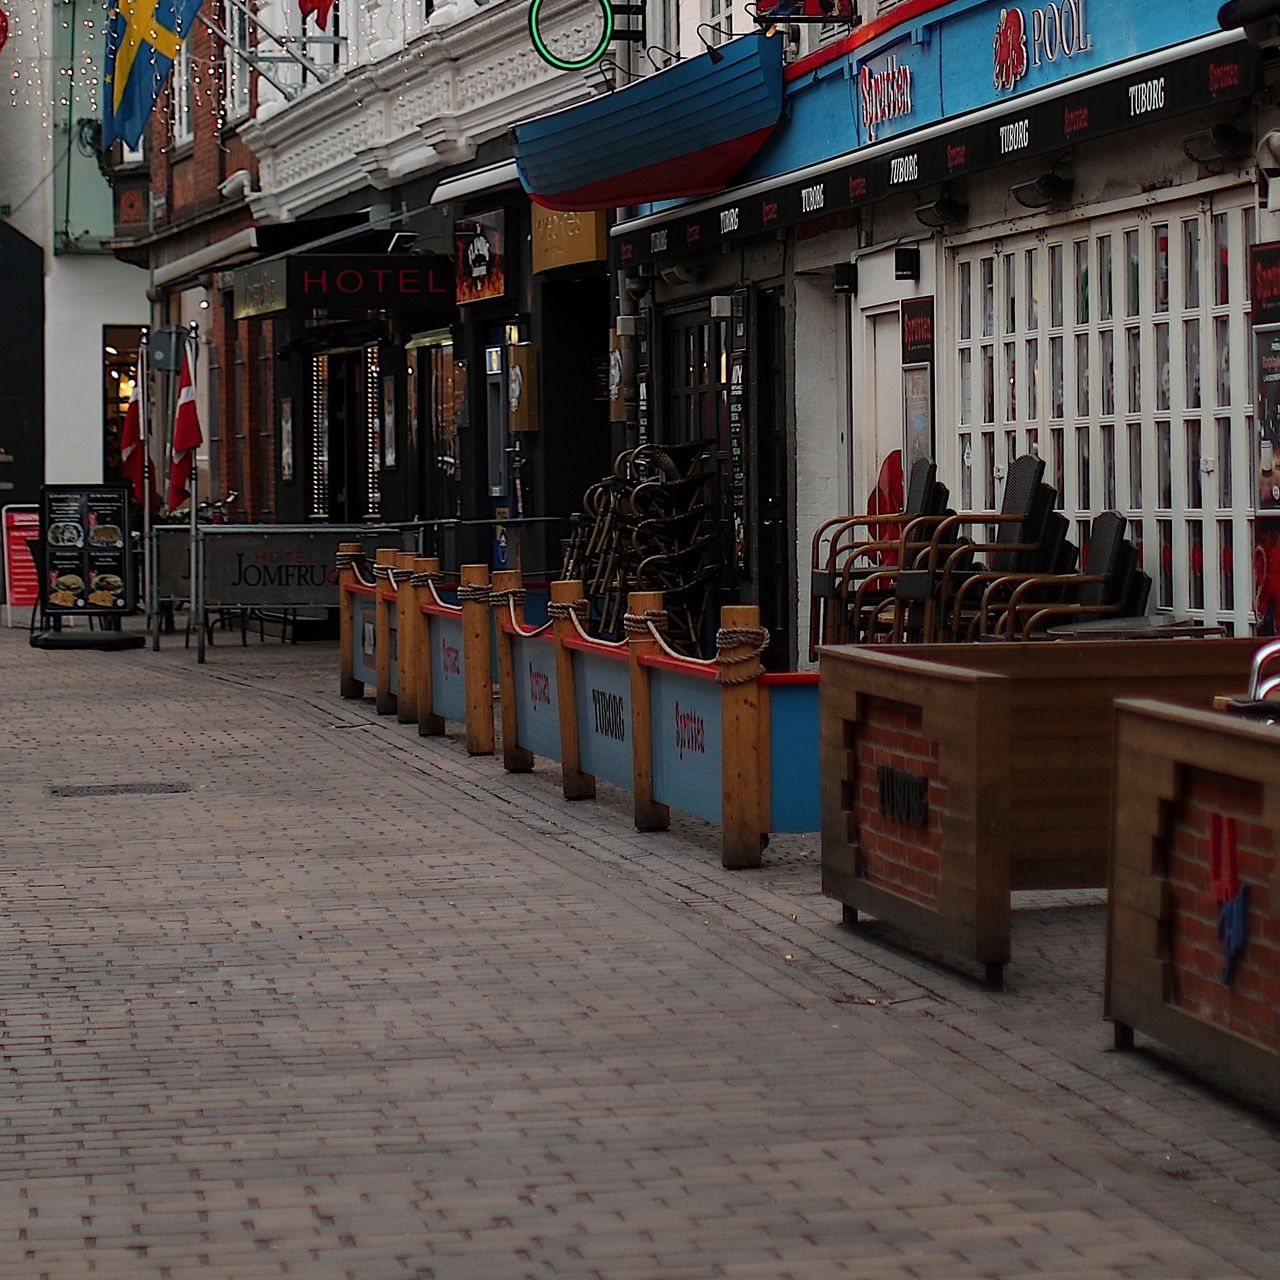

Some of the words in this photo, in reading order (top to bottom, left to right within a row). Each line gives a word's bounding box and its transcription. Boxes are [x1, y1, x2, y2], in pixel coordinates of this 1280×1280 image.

[860, 54, 913, 142] Sprutten
[1128, 77, 1165, 117] TUBORG
[999, 118, 1030, 155] TUBORG
[889, 154, 919, 185] TUBORG
[303, 268, 448, 295] HOTEL
[231, 553, 329, 587] JOMFRU
[255, 551, 317, 564] HOTEL
[592, 688, 625, 743] TUBORG
